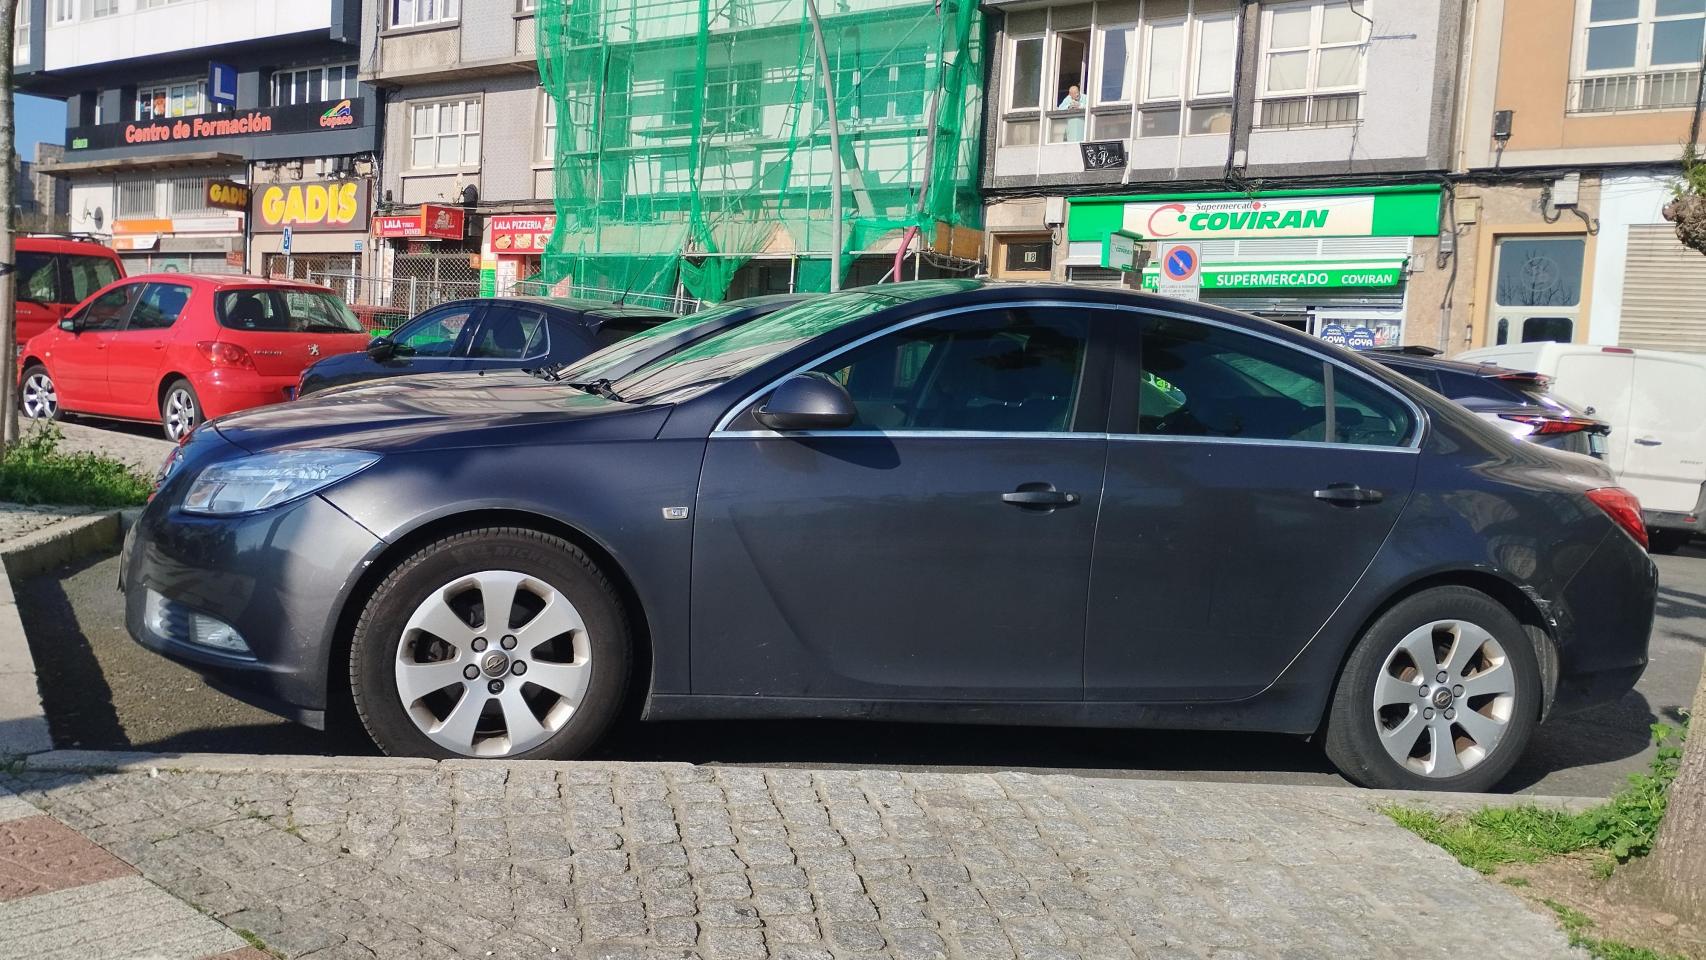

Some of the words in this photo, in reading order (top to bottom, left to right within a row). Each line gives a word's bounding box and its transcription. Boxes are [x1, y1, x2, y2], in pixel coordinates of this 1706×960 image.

[214, 67, 234, 100] L
[125, 123, 170, 144] Centro
[172, 120, 191, 139] de
[193, 113, 272, 137] Formación
[209, 183, 247, 205] GADIS
[261, 182, 358, 225] GADIS
[384, 220, 401, 229] LALA
[494, 221, 511, 230] LALA
[512, 220, 542, 230] PIZZERIA
[1189, 210, 1330, 231] COVIRAN
[1026, 253, 1036, 261] 18
[1216, 272, 1329, 286] SUPERMERCADO
[1341, 274, 1393, 284] COVIRAN
[1322, 335, 1346, 344] GOYA
[1348, 338, 1373, 347] GOYA
